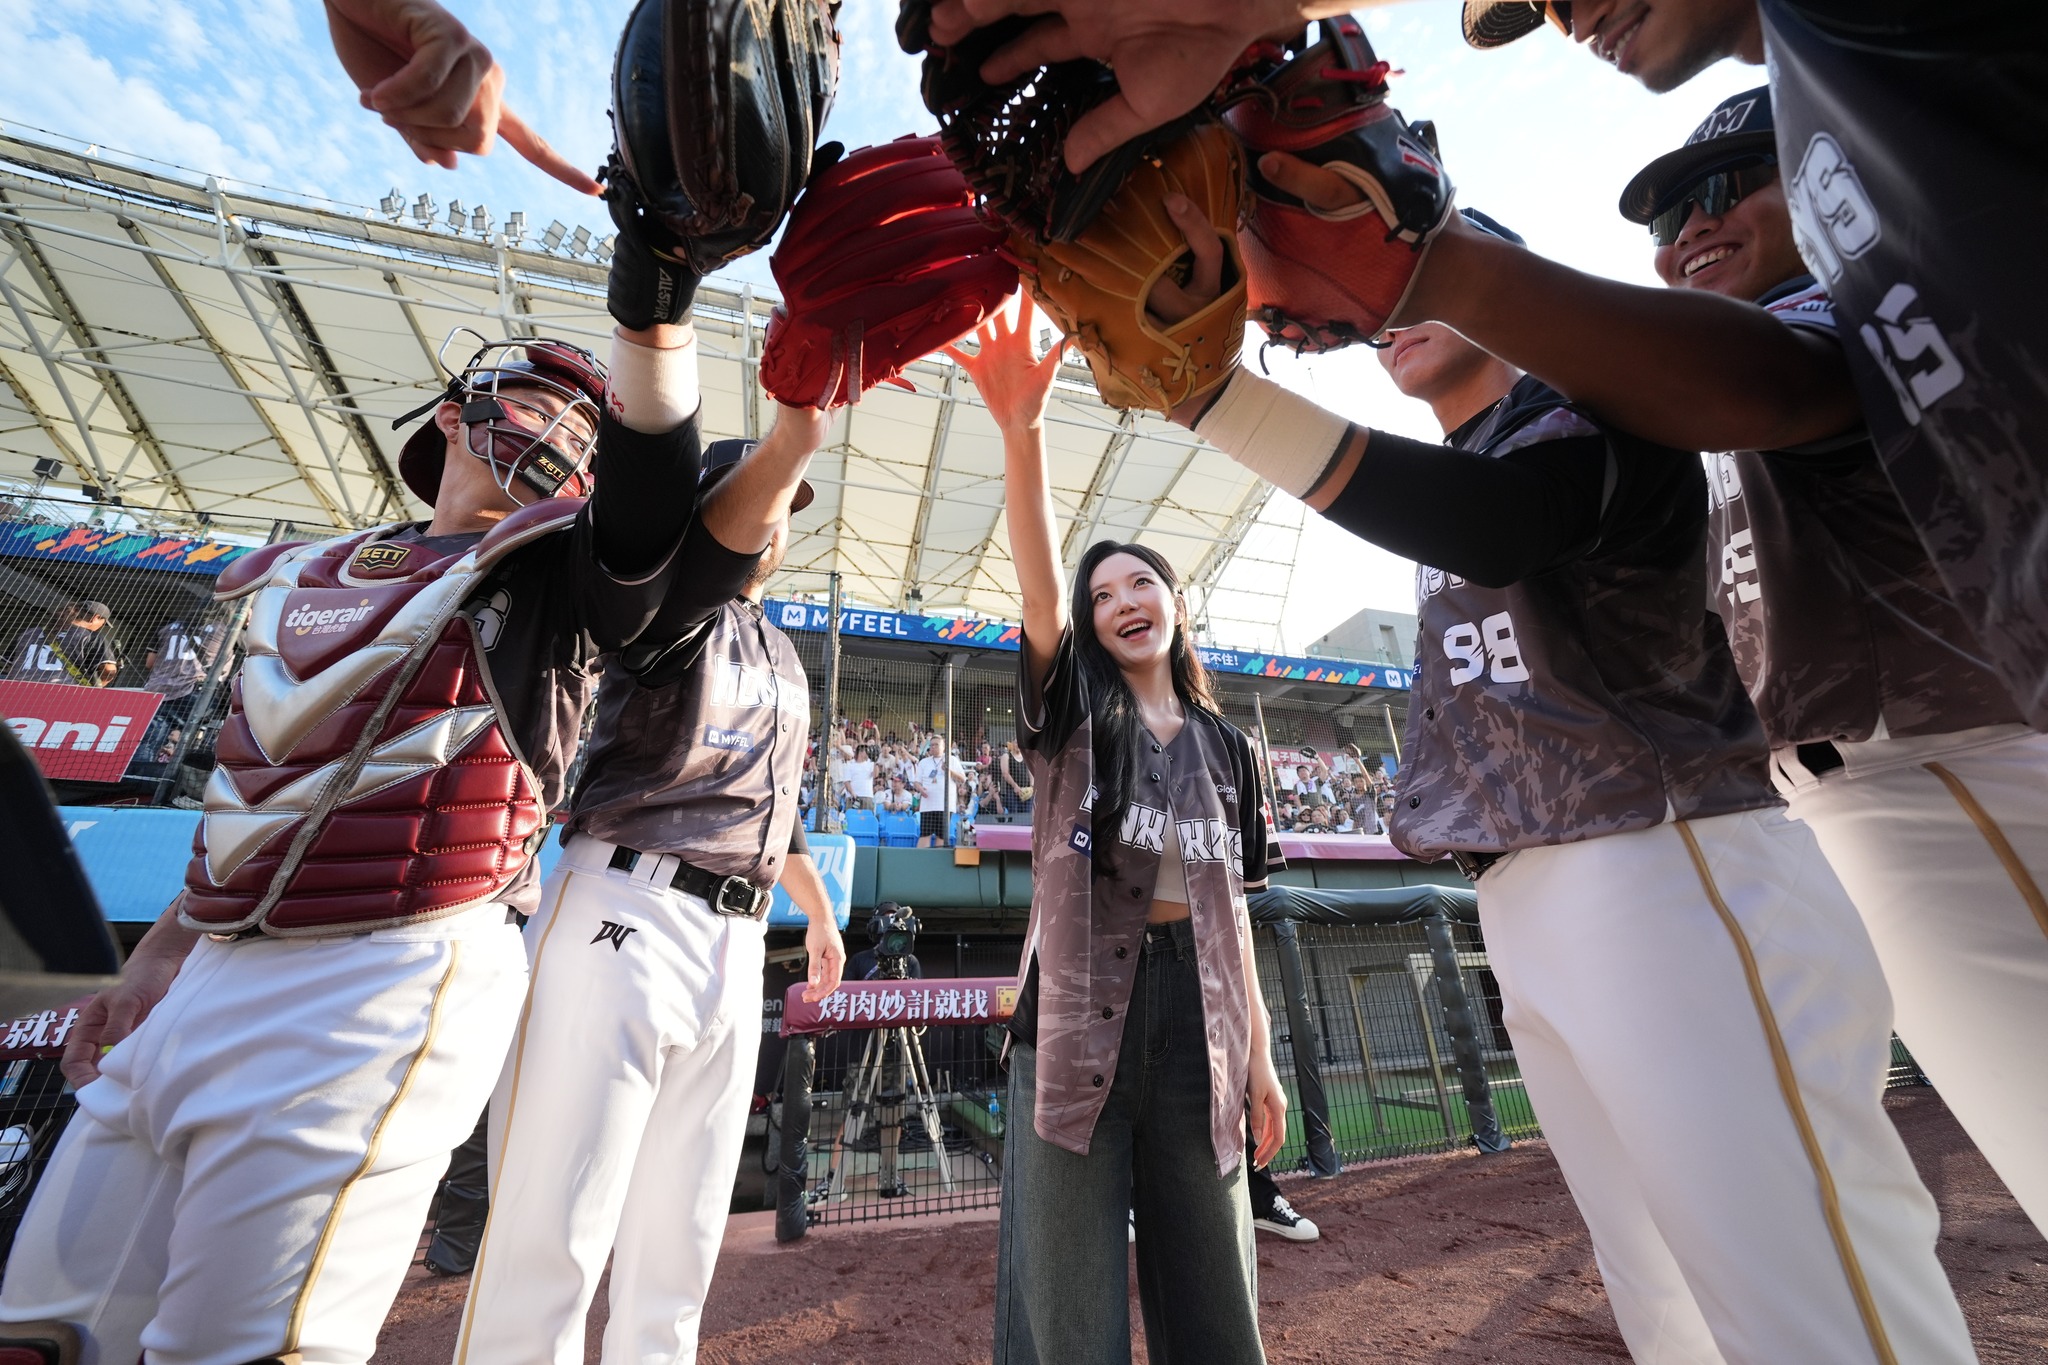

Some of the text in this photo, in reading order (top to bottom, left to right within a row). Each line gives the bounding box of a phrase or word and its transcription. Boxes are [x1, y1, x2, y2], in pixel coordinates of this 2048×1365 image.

[537, 456, 566, 478] ZETT
[359, 547, 405, 561] ZETT
[285, 598, 375, 636] tigerair
[1443, 610, 1530, 687] 98
[818, 988, 989, 1021] 烤肉妙計就找
